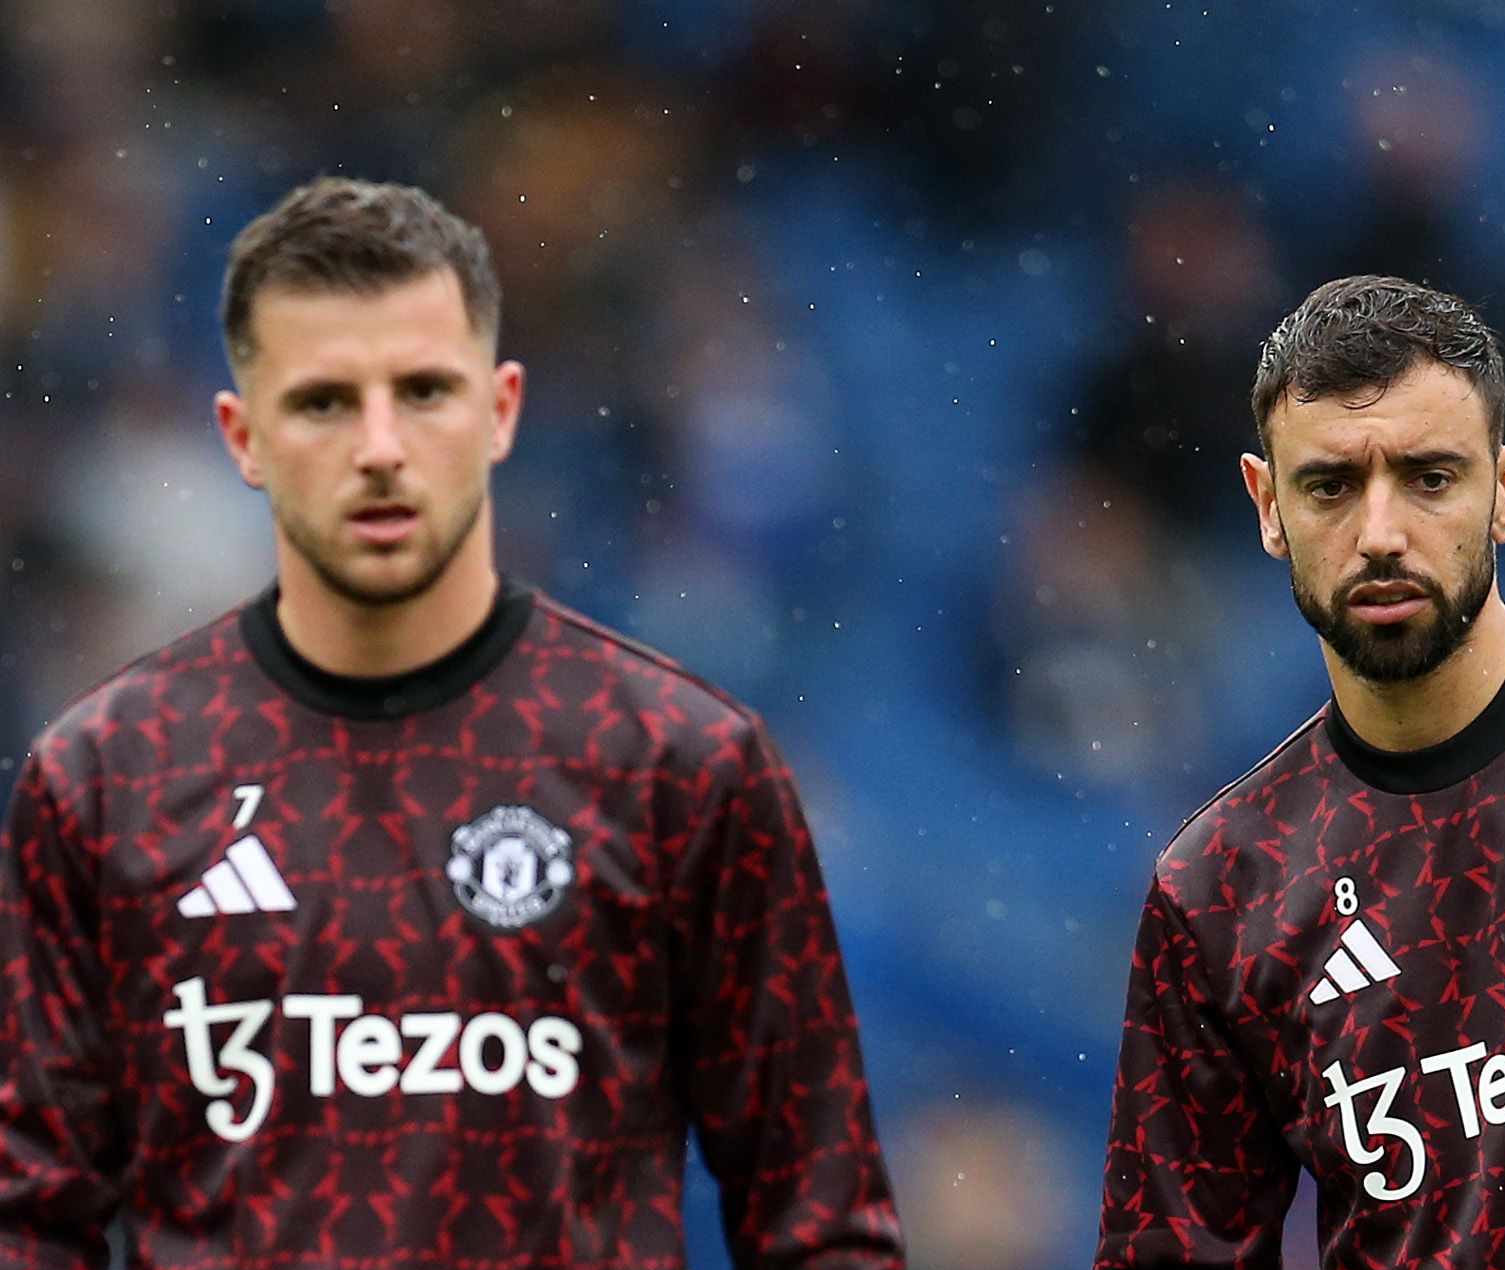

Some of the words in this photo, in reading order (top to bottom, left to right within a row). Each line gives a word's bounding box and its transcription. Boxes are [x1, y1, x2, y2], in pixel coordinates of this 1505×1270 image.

[233, 785, 263, 829] 7
[1334, 876, 1359, 915] 8
[282, 995, 582, 1098] Tezos
